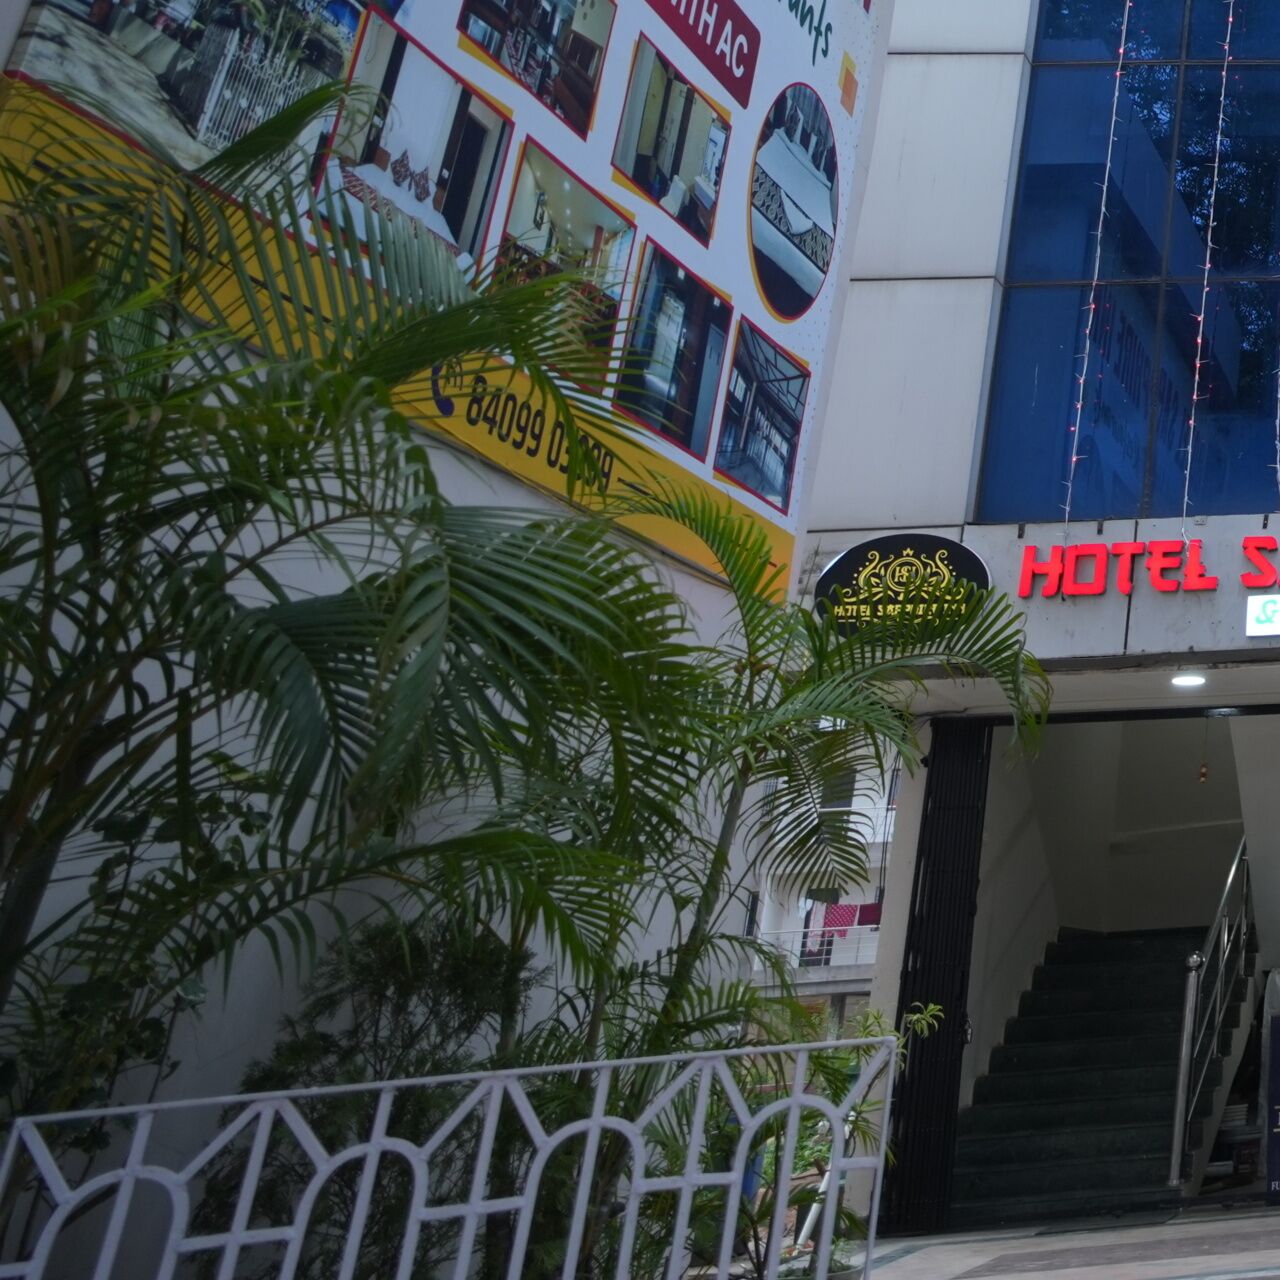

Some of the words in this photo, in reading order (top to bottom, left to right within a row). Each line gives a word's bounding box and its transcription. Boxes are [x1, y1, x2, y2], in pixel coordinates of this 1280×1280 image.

[714, 12, 749, 80] AC
[466, 374, 546, 458] 84099
[1017, 537, 1219, 599] HOTEL
